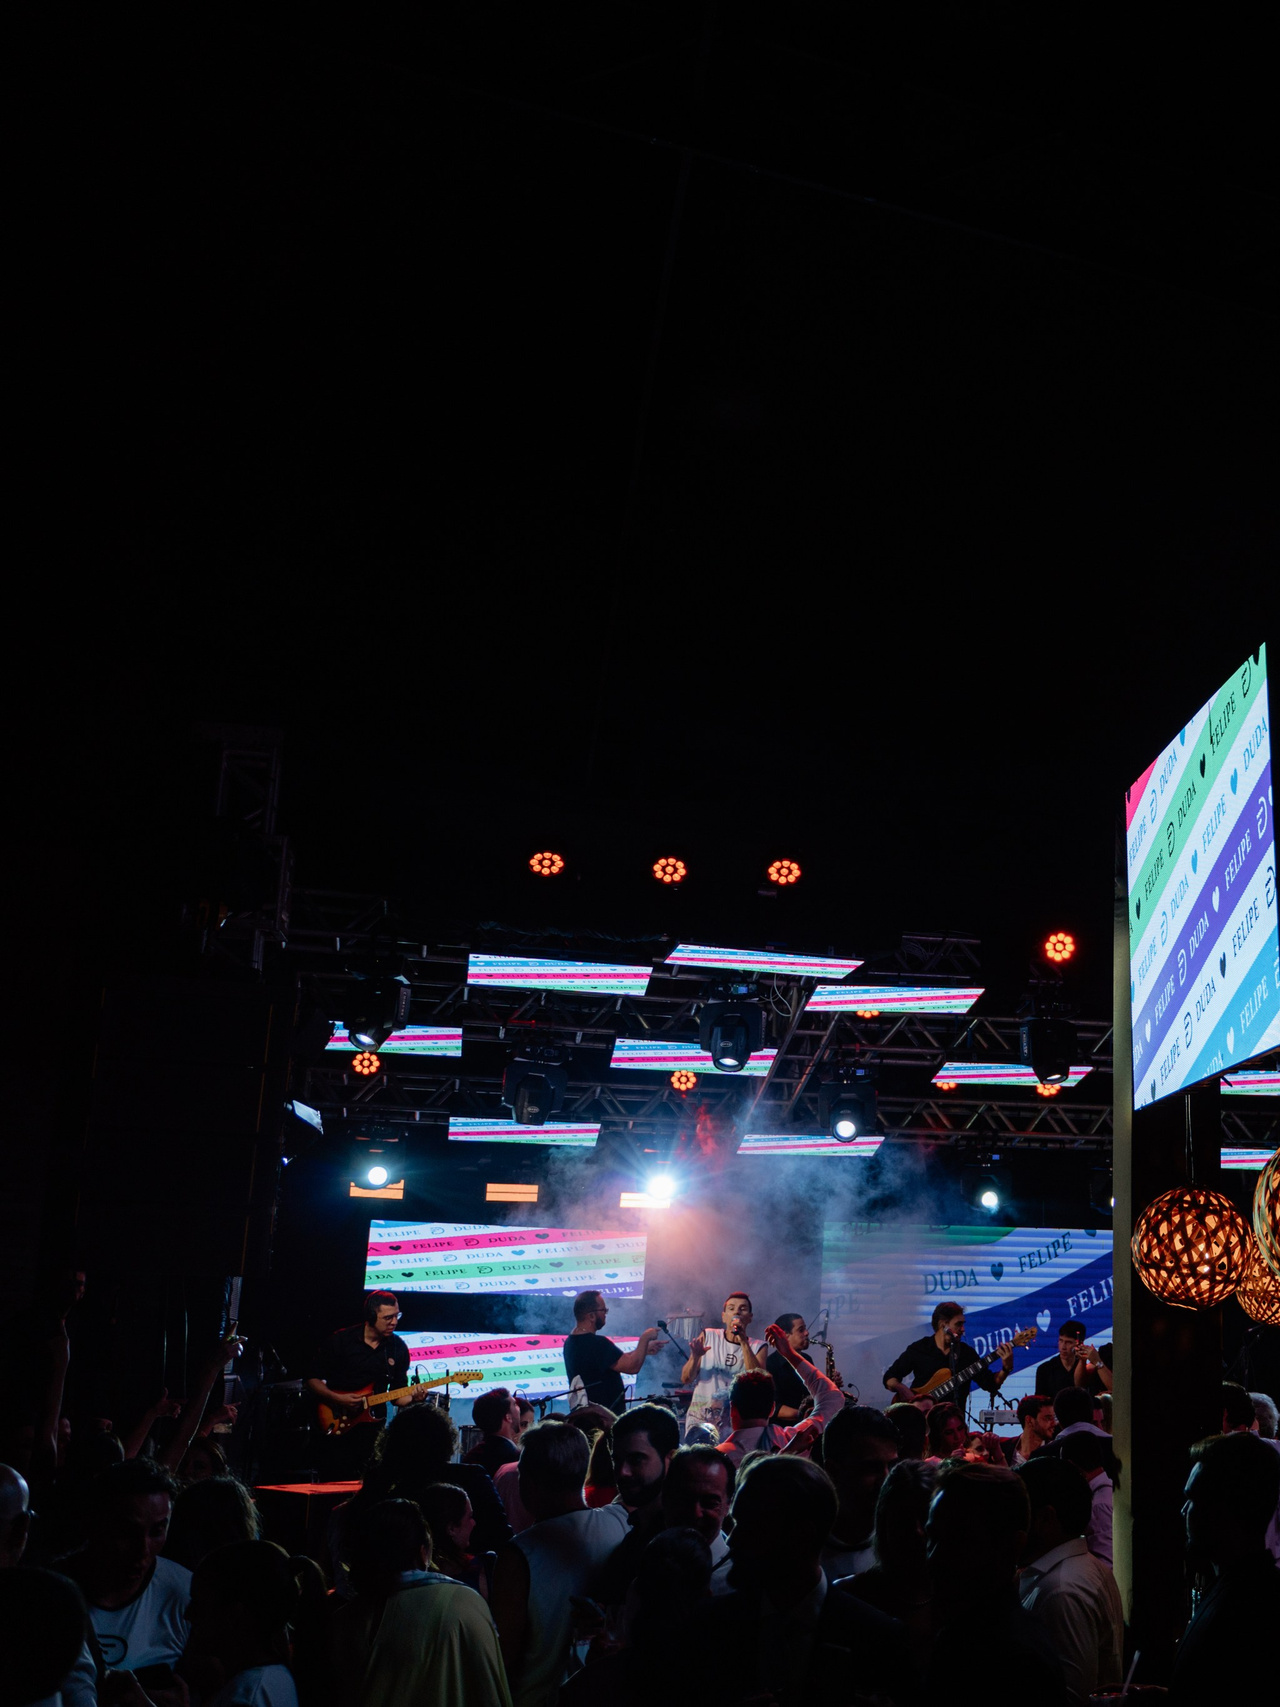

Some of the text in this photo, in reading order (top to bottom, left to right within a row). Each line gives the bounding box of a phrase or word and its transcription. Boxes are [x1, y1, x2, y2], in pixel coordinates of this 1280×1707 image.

[488, 1234, 526, 1243] DUDA
[502, 1263, 540, 1271] DUDA
[924, 1267, 980, 1295] DUDA
[1018, 1231, 1074, 1274] FELIPE
[599, 1286, 635, 1295] ELIPE
[410, 1342, 517, 1357] ELIPE DUDA
[493, 1369, 532, 1377] DUDA
